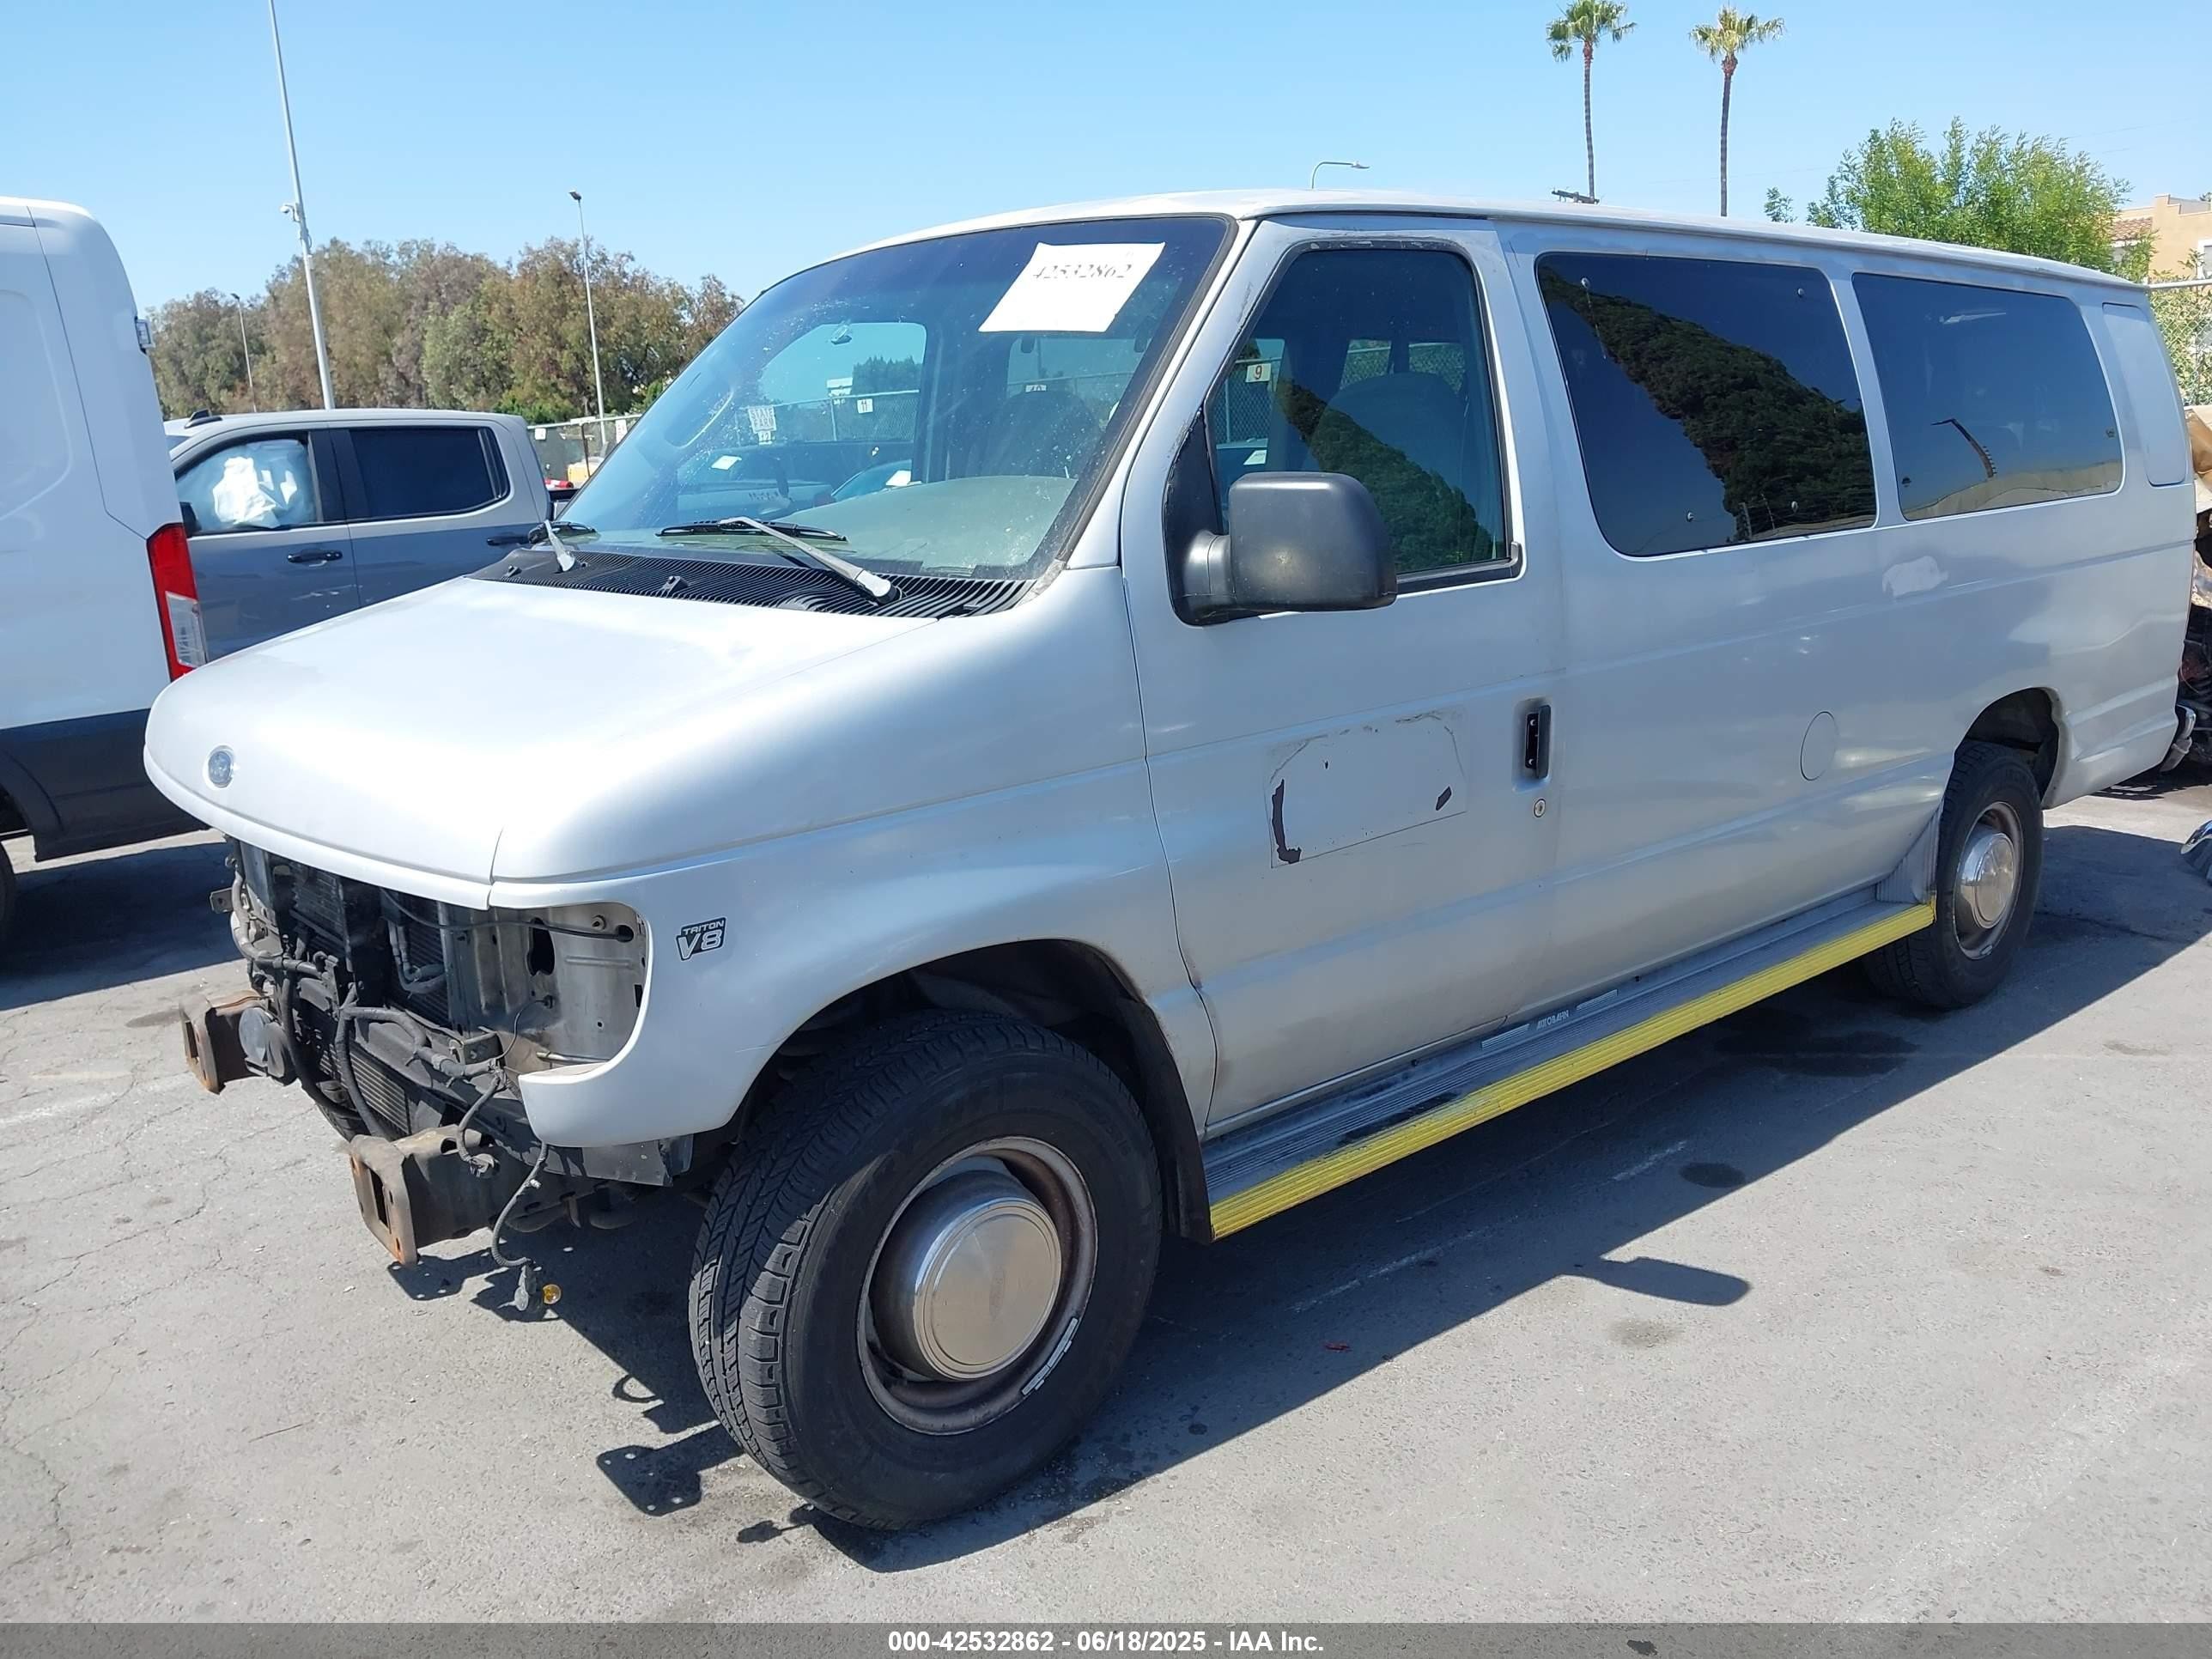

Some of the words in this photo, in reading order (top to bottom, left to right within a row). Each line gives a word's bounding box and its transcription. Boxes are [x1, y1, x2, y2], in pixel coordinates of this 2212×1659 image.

[1255, 365, 1262, 380] 9
[683, 920, 725, 935] TRITON
[678, 929, 722, 959] V8
[1537, 1009, 1570, 1030] AUTOBAHN
